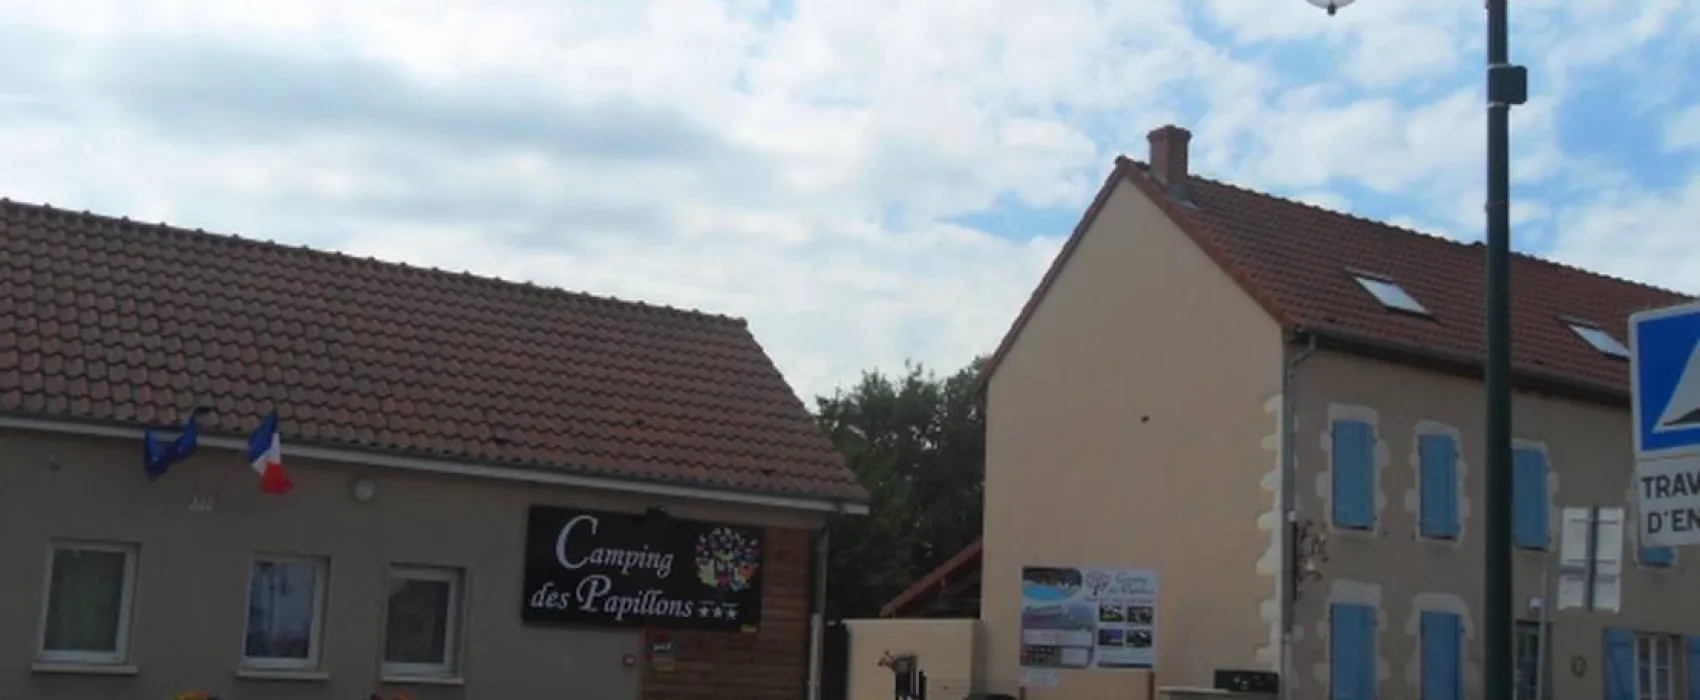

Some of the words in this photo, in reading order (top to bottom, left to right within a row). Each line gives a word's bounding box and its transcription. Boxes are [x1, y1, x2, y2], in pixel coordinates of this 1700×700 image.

[556, 514, 674, 578] Camping
[530, 582, 571, 609] des
[575, 574, 695, 621] Papillons
